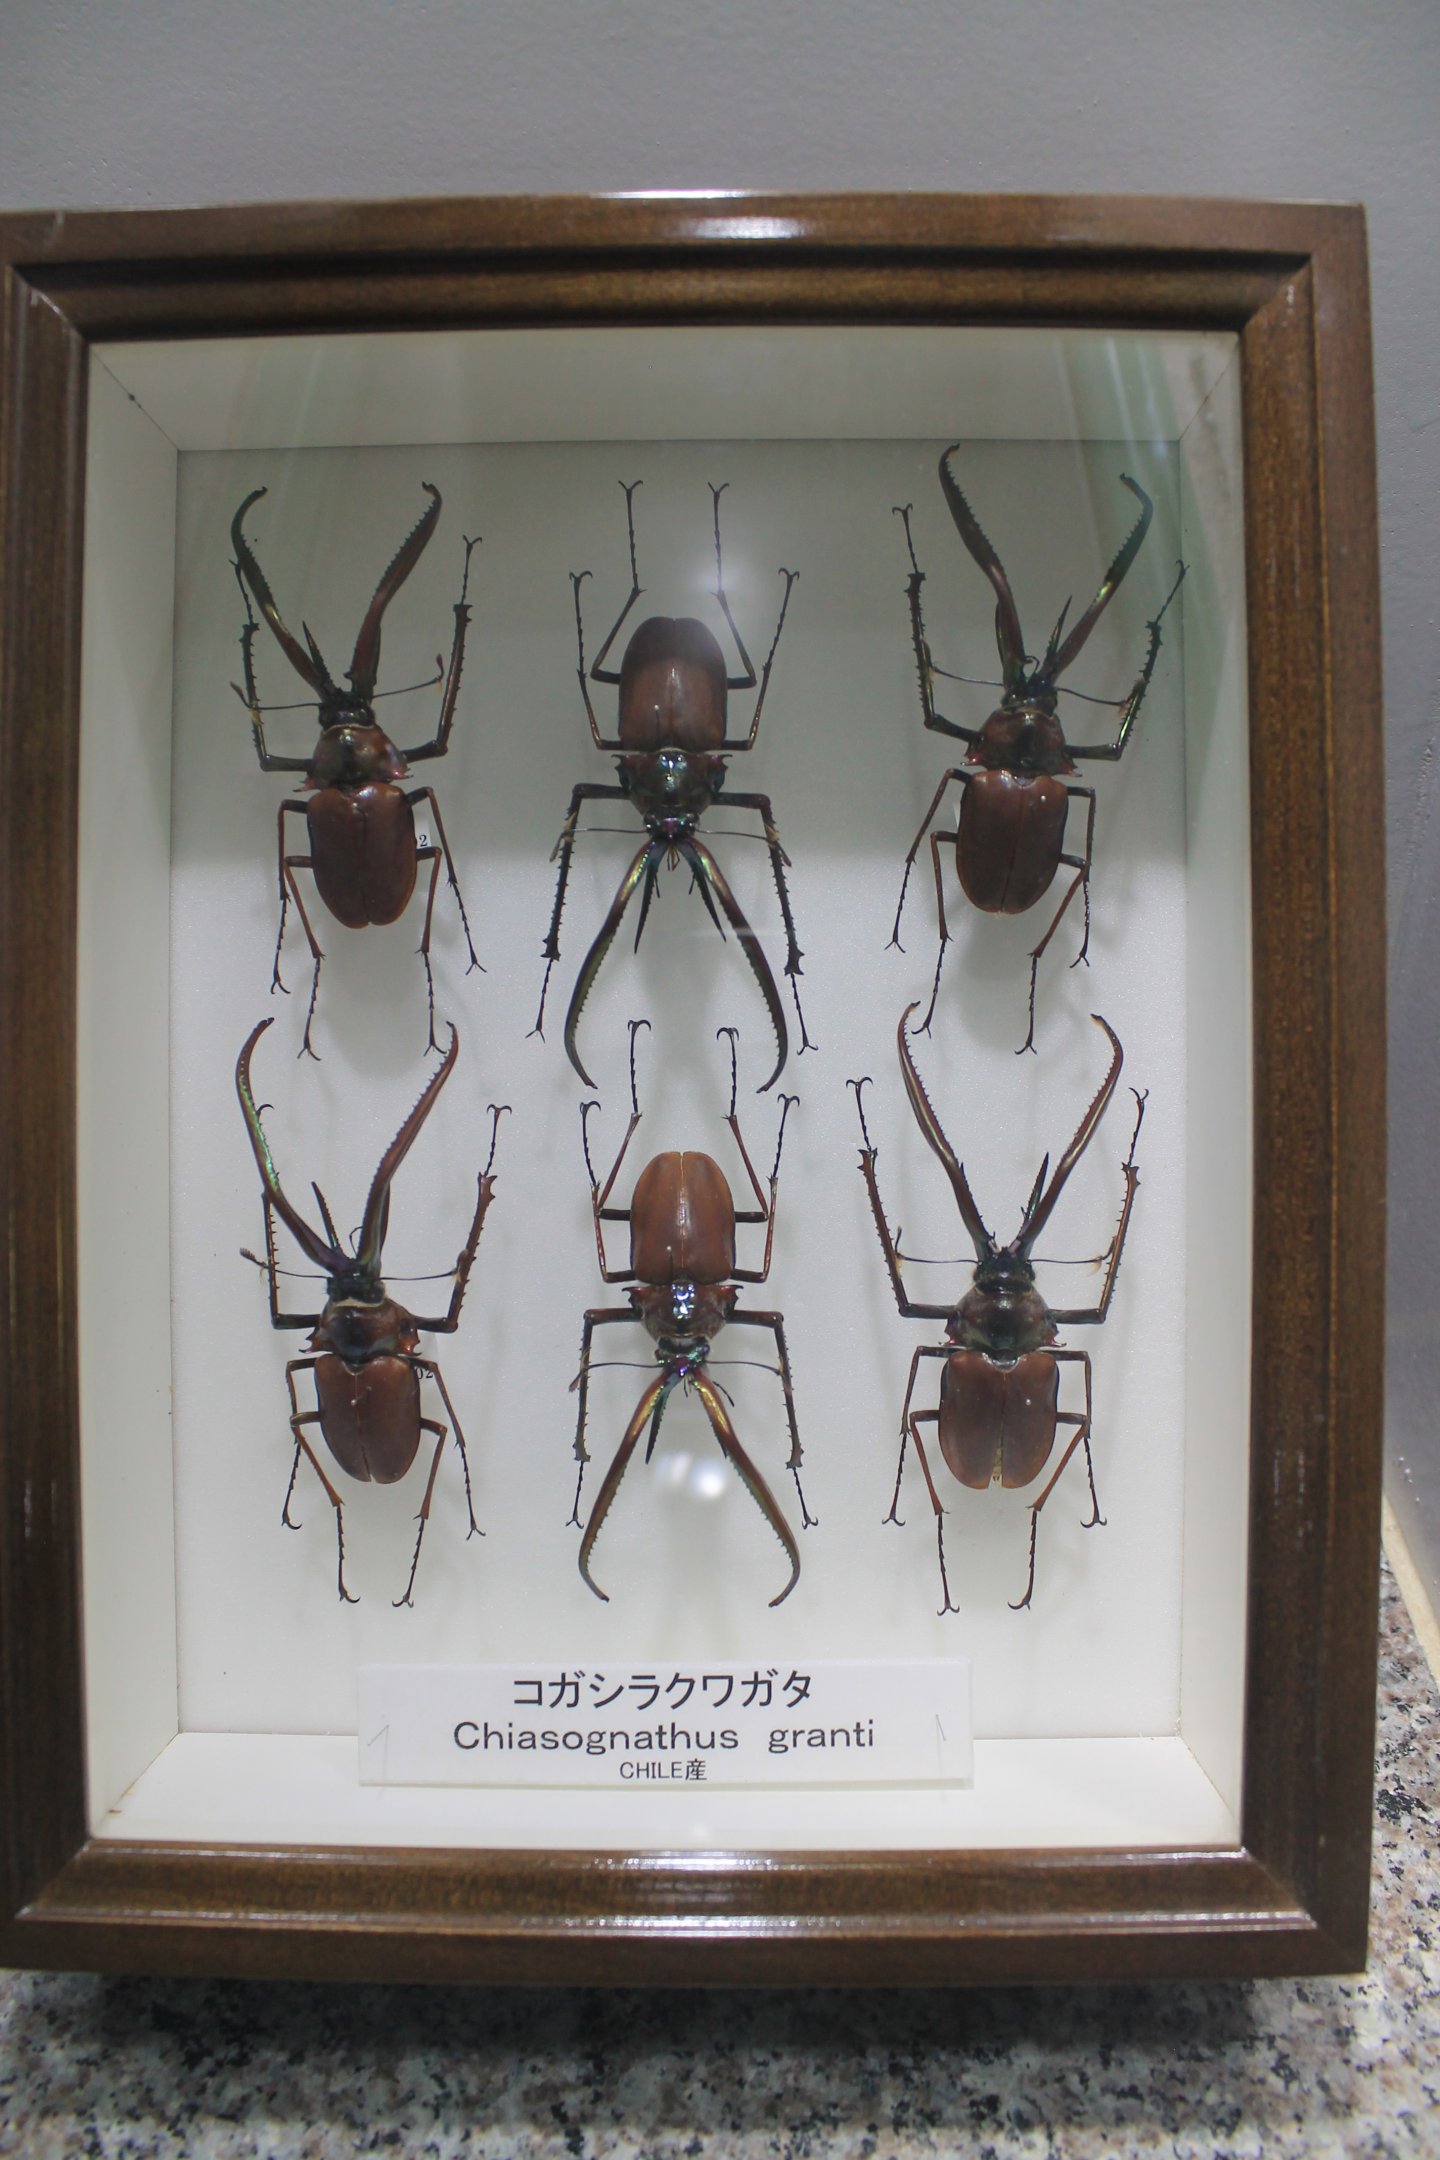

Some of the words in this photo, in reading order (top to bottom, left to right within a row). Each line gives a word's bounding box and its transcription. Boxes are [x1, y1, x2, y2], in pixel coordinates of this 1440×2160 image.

[513, 1668, 811, 1710] コガシラクワガタ
[453, 1720, 739, 1755] Chiasognathus
[768, 1720, 874, 1754] granti
[619, 1758, 707, 1781] CHILE産
